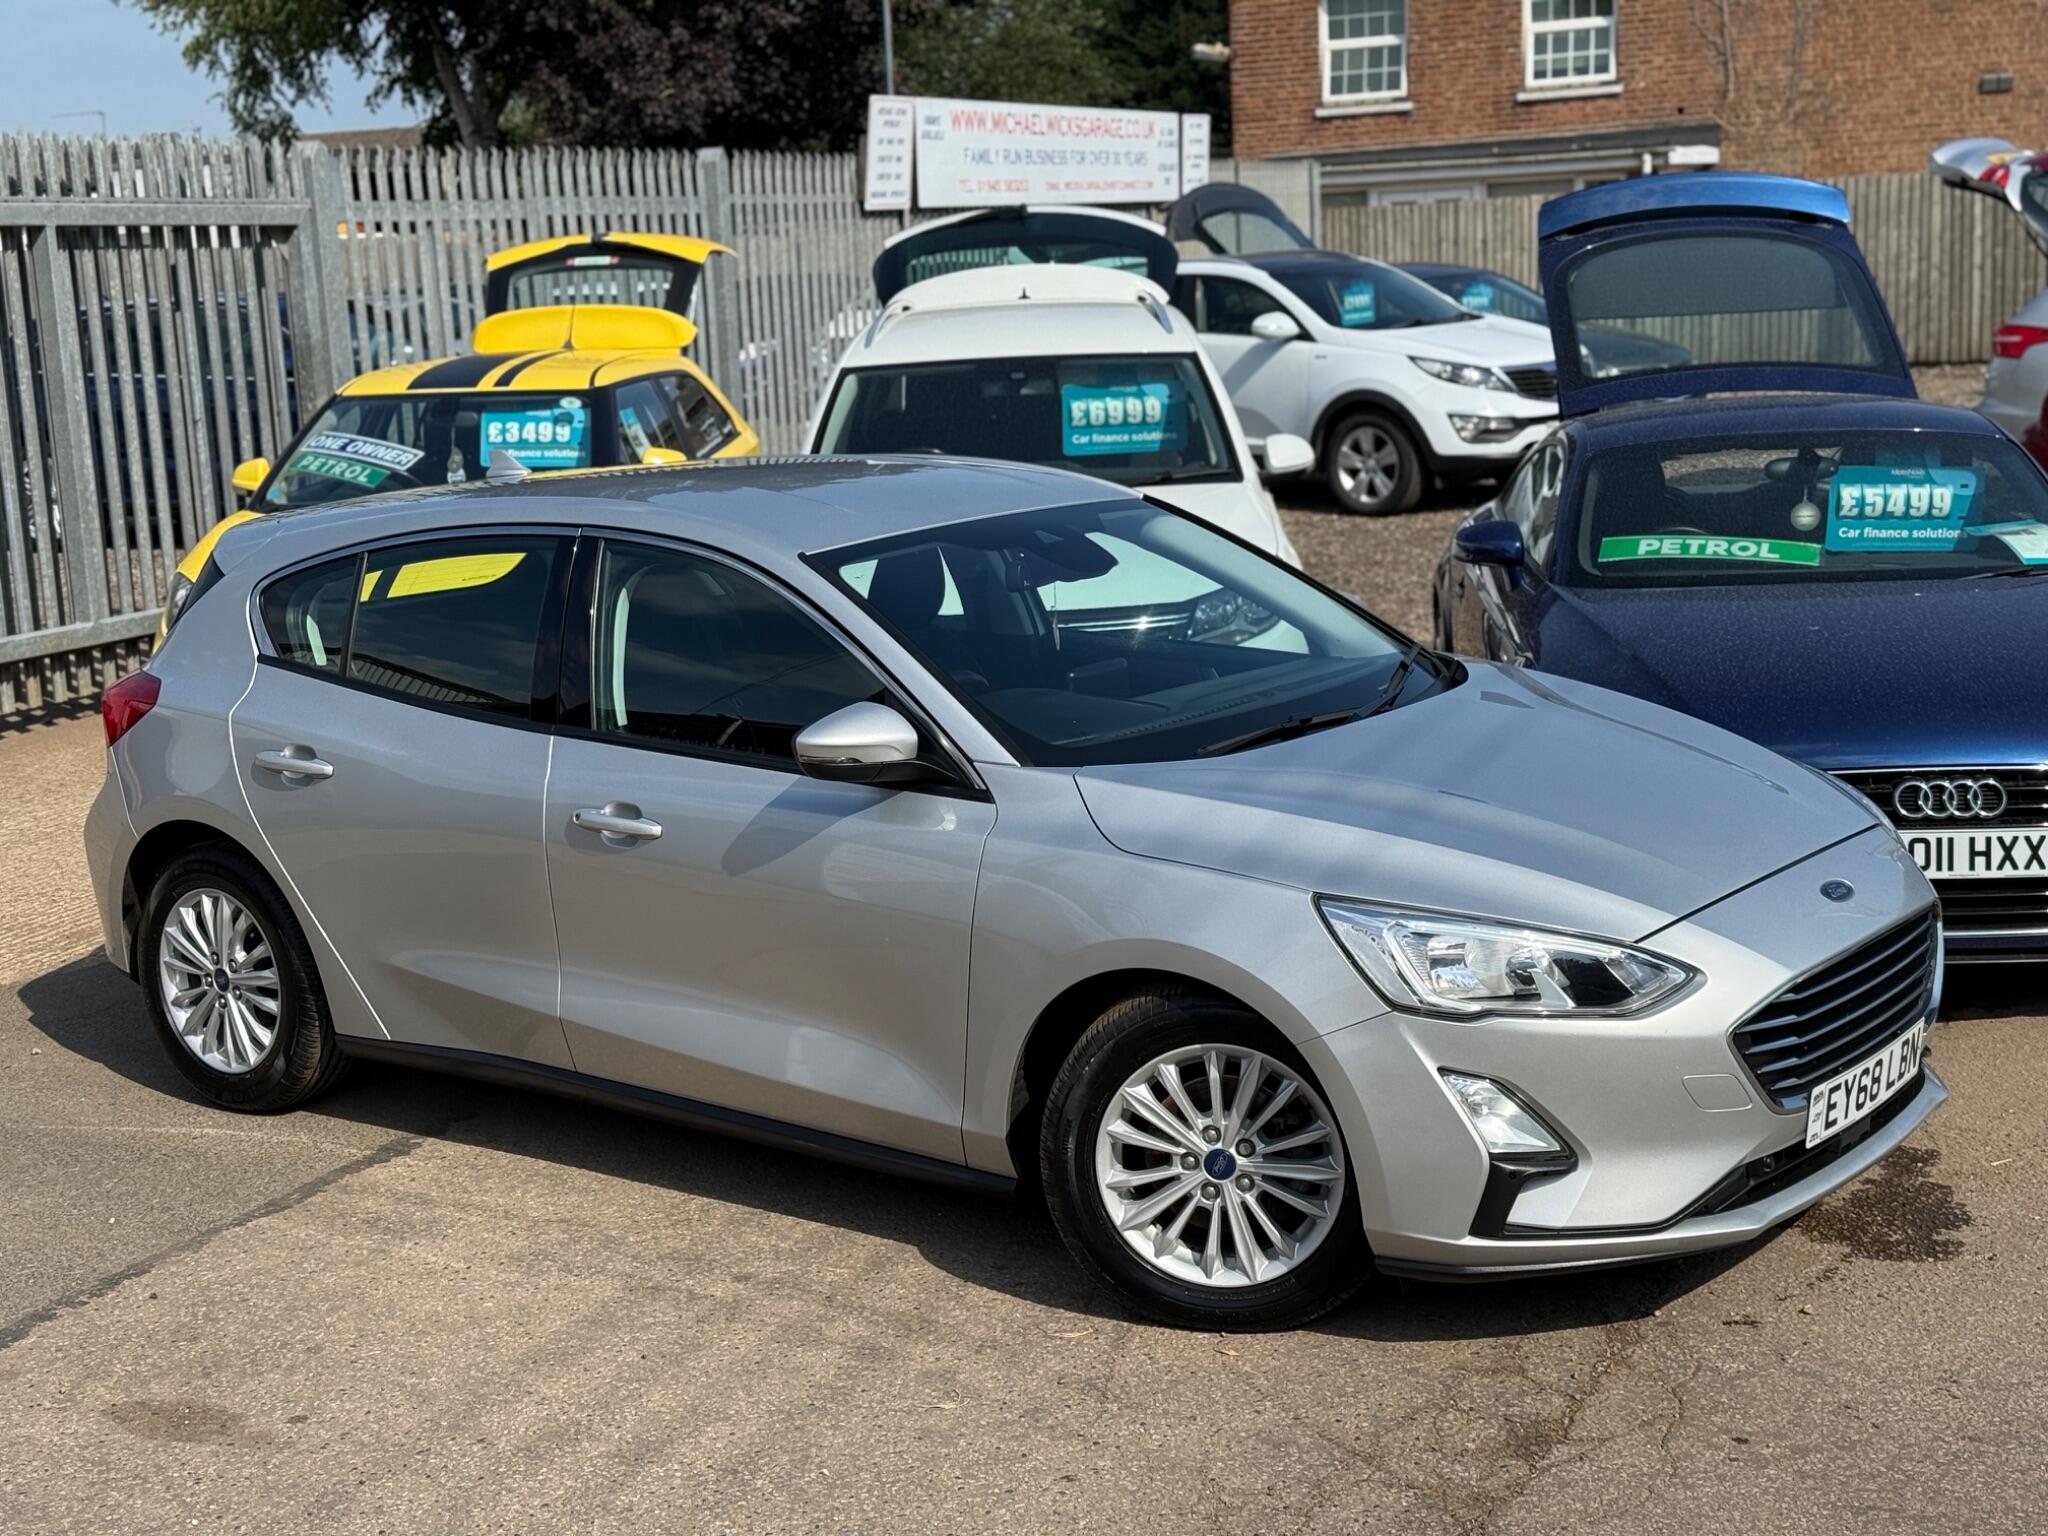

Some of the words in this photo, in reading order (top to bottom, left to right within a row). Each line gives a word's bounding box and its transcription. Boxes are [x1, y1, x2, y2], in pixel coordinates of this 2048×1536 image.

[1070, 396, 1162, 427] £6999
[487, 421, 571, 443] £3499
[1072, 434, 1090, 444] Car
[1092, 432, 1129, 443] finance
[1131, 431, 1178, 442] solutions
[310, 435, 350, 450] ONE
[345, 440, 416, 466] OWNER
[297, 455, 373, 483] PETROL
[1839, 484, 1954, 518] £5499
[1838, 527, 1862, 539] Car
[1863, 526, 1910, 539] finance
[1911, 527, 1969, 539] solutions
[1637, 538, 1781, 560] PETROL
[1968, 834, 2047, 872] HXX
[1823, 1057, 1884, 1132] EY68
[1884, 1026, 1921, 1093] LBN
